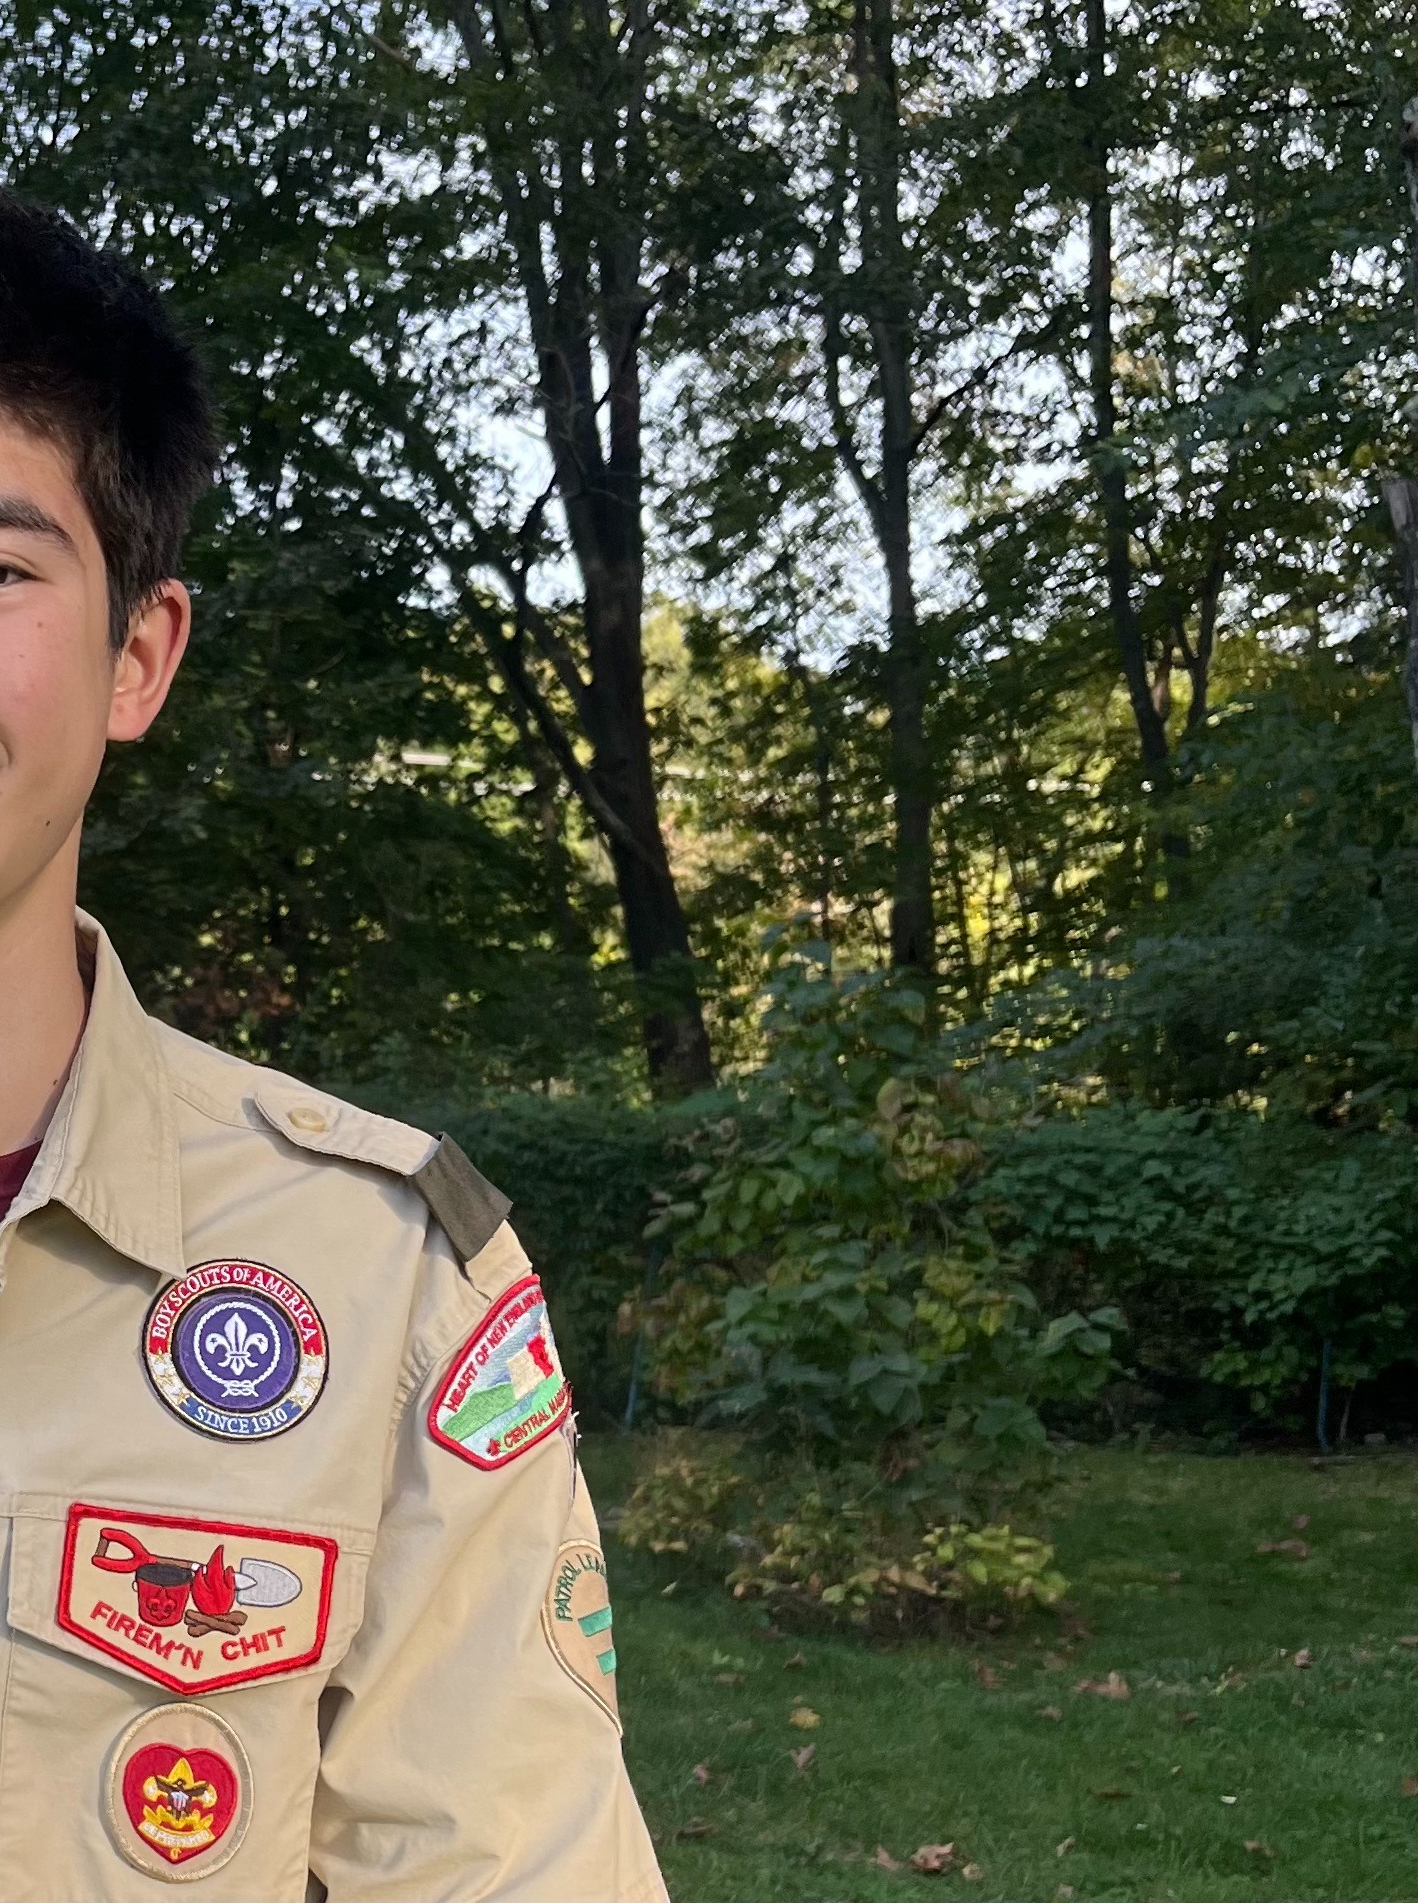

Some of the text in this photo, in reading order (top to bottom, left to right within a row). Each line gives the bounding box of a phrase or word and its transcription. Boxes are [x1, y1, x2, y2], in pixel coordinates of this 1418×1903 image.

[152, 1265, 318, 1342] BOY SCOUTS OF AMERICA
[442, 1362, 479, 1413] HEART
[474, 1343, 490, 1366] OF
[194, 1405, 288, 1434] SINCE 1910
[504, 1407, 551, 1448] CENTRAL
[553, 1559, 582, 1622] PATROL
[89, 1600, 287, 1671] FIREM'N CHIT
